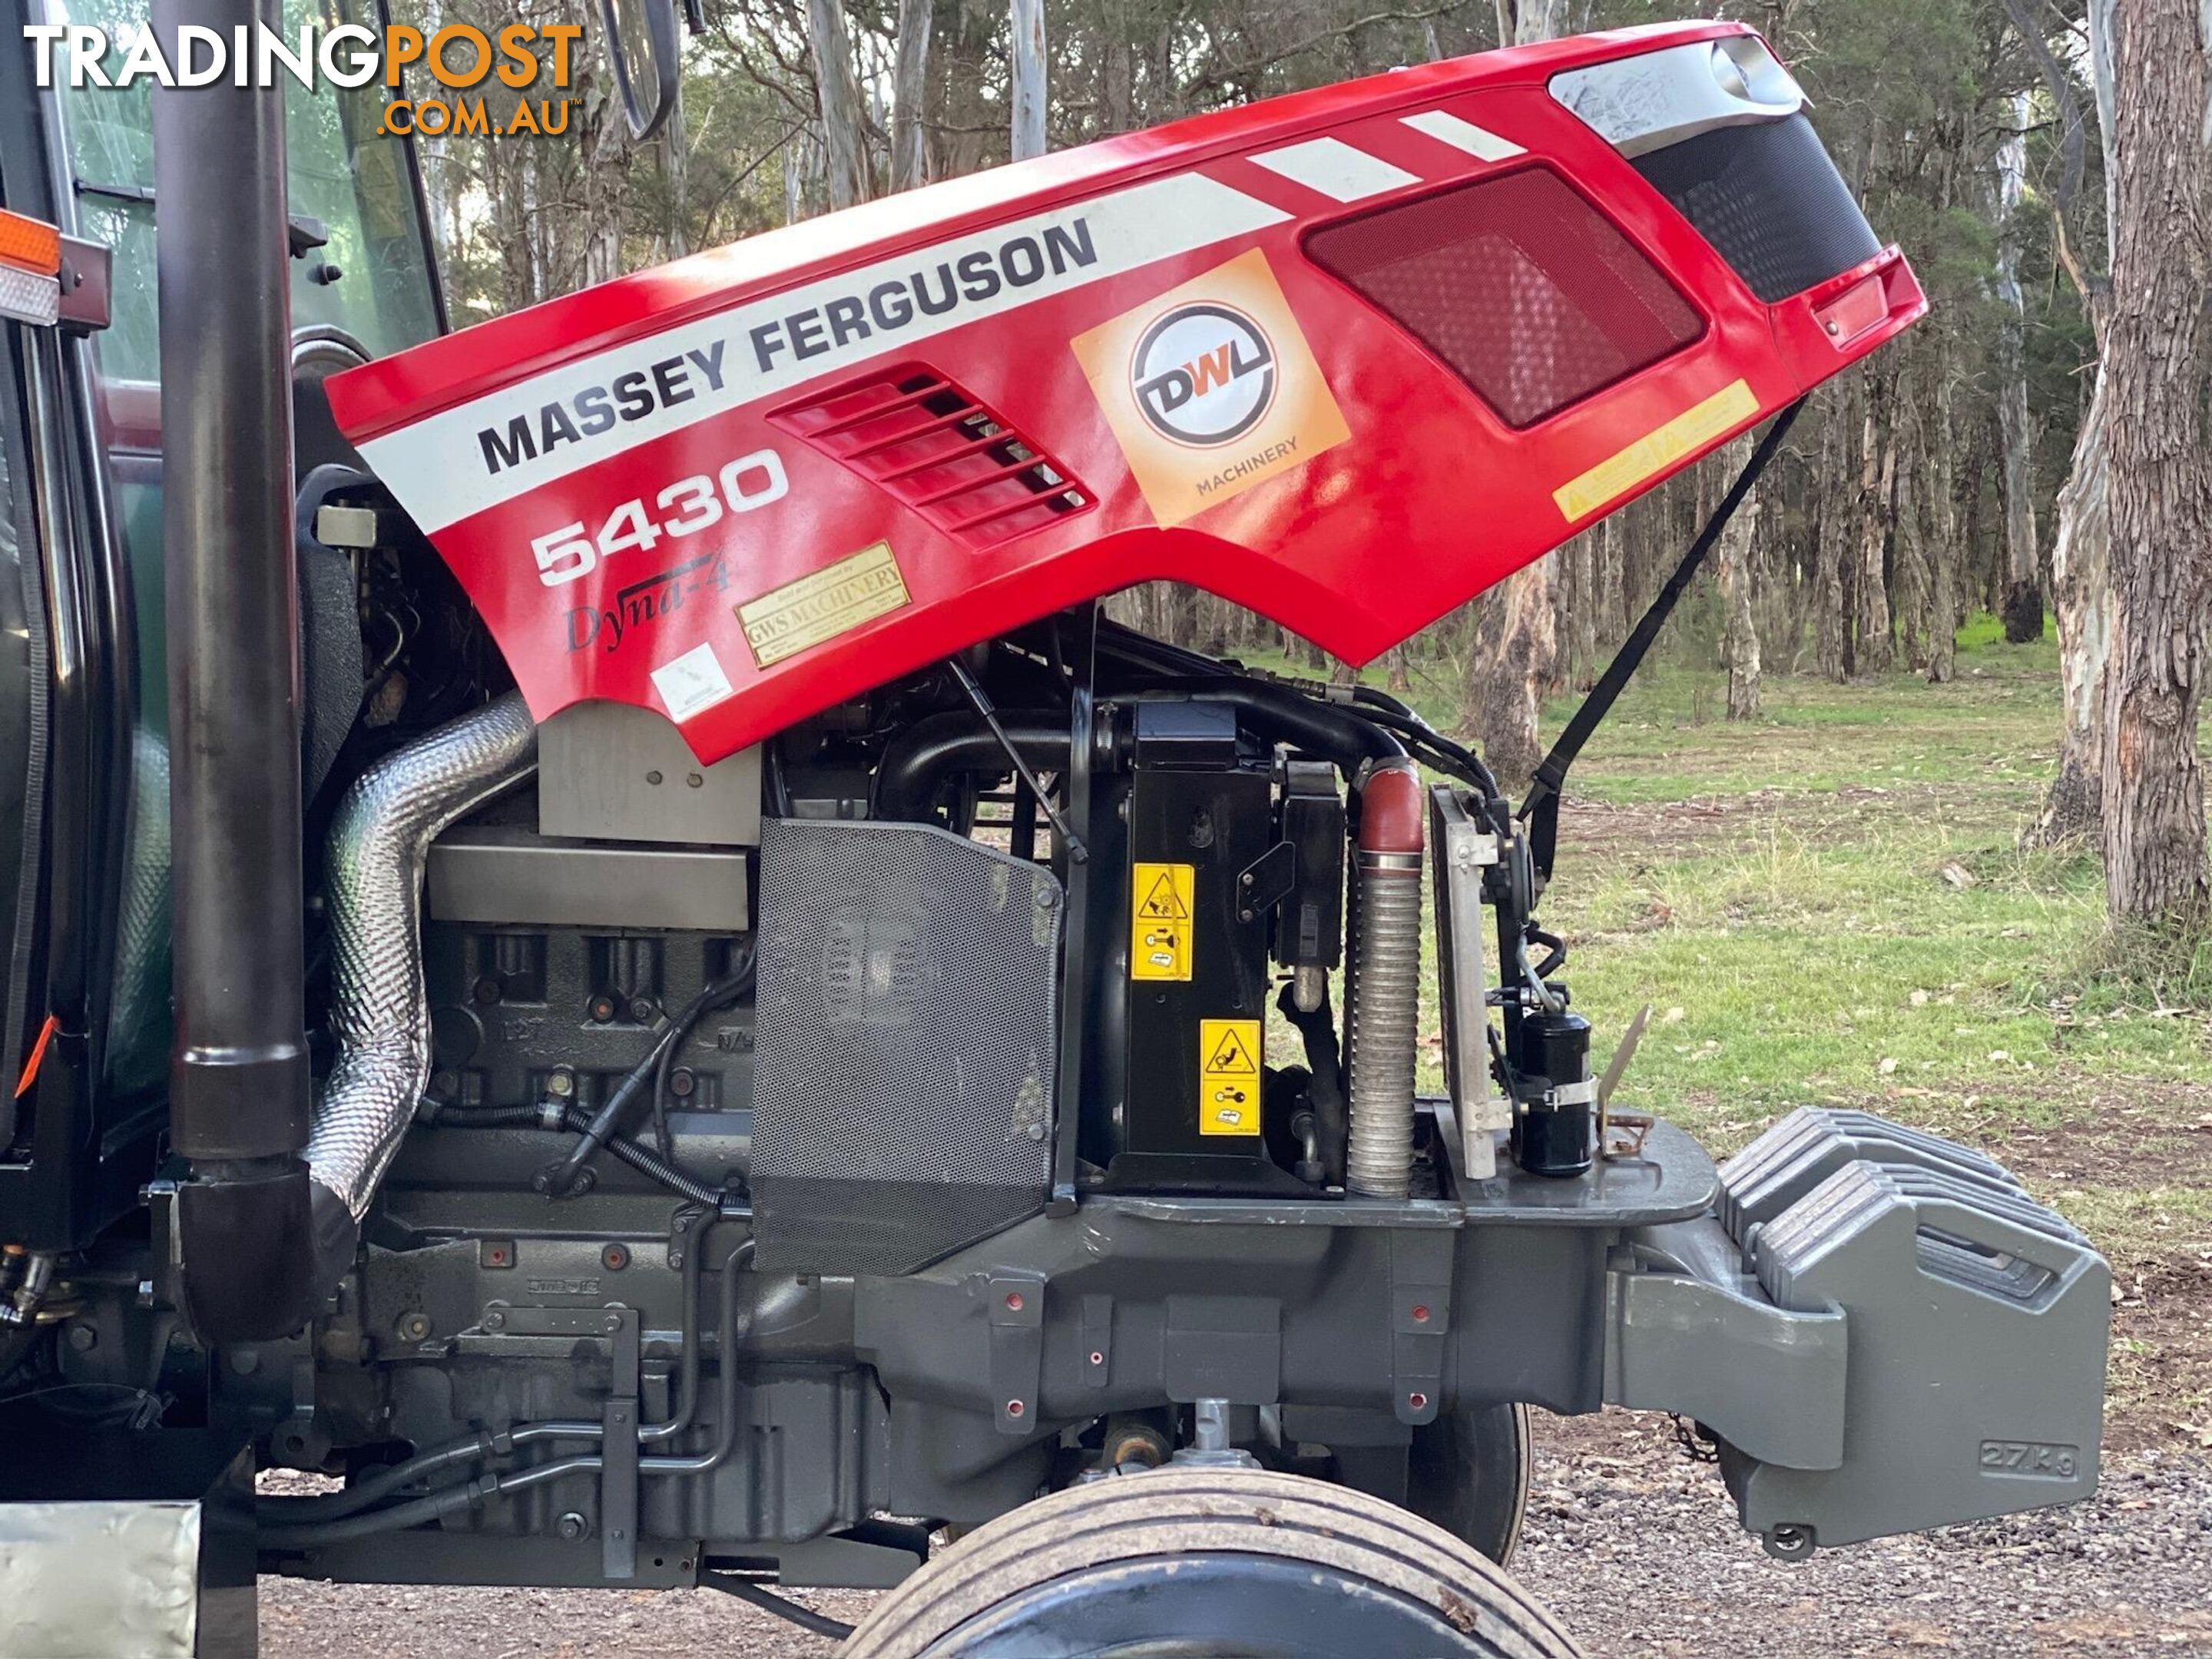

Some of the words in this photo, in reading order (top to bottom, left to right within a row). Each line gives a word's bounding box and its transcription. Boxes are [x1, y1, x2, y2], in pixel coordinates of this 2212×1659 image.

[478, 339, 727, 475] MASSEY
[749, 217, 1098, 374] FERGUSON
[1143, 339, 1267, 414] DWL
[1196, 436, 1300, 497] MACHINERY
[530, 449, 790, 588] 5430
[563, 544, 733, 653] Dyna-4
[747, 614, 789, 644] GWS
[791, 567, 900, 628] MACHINERY
